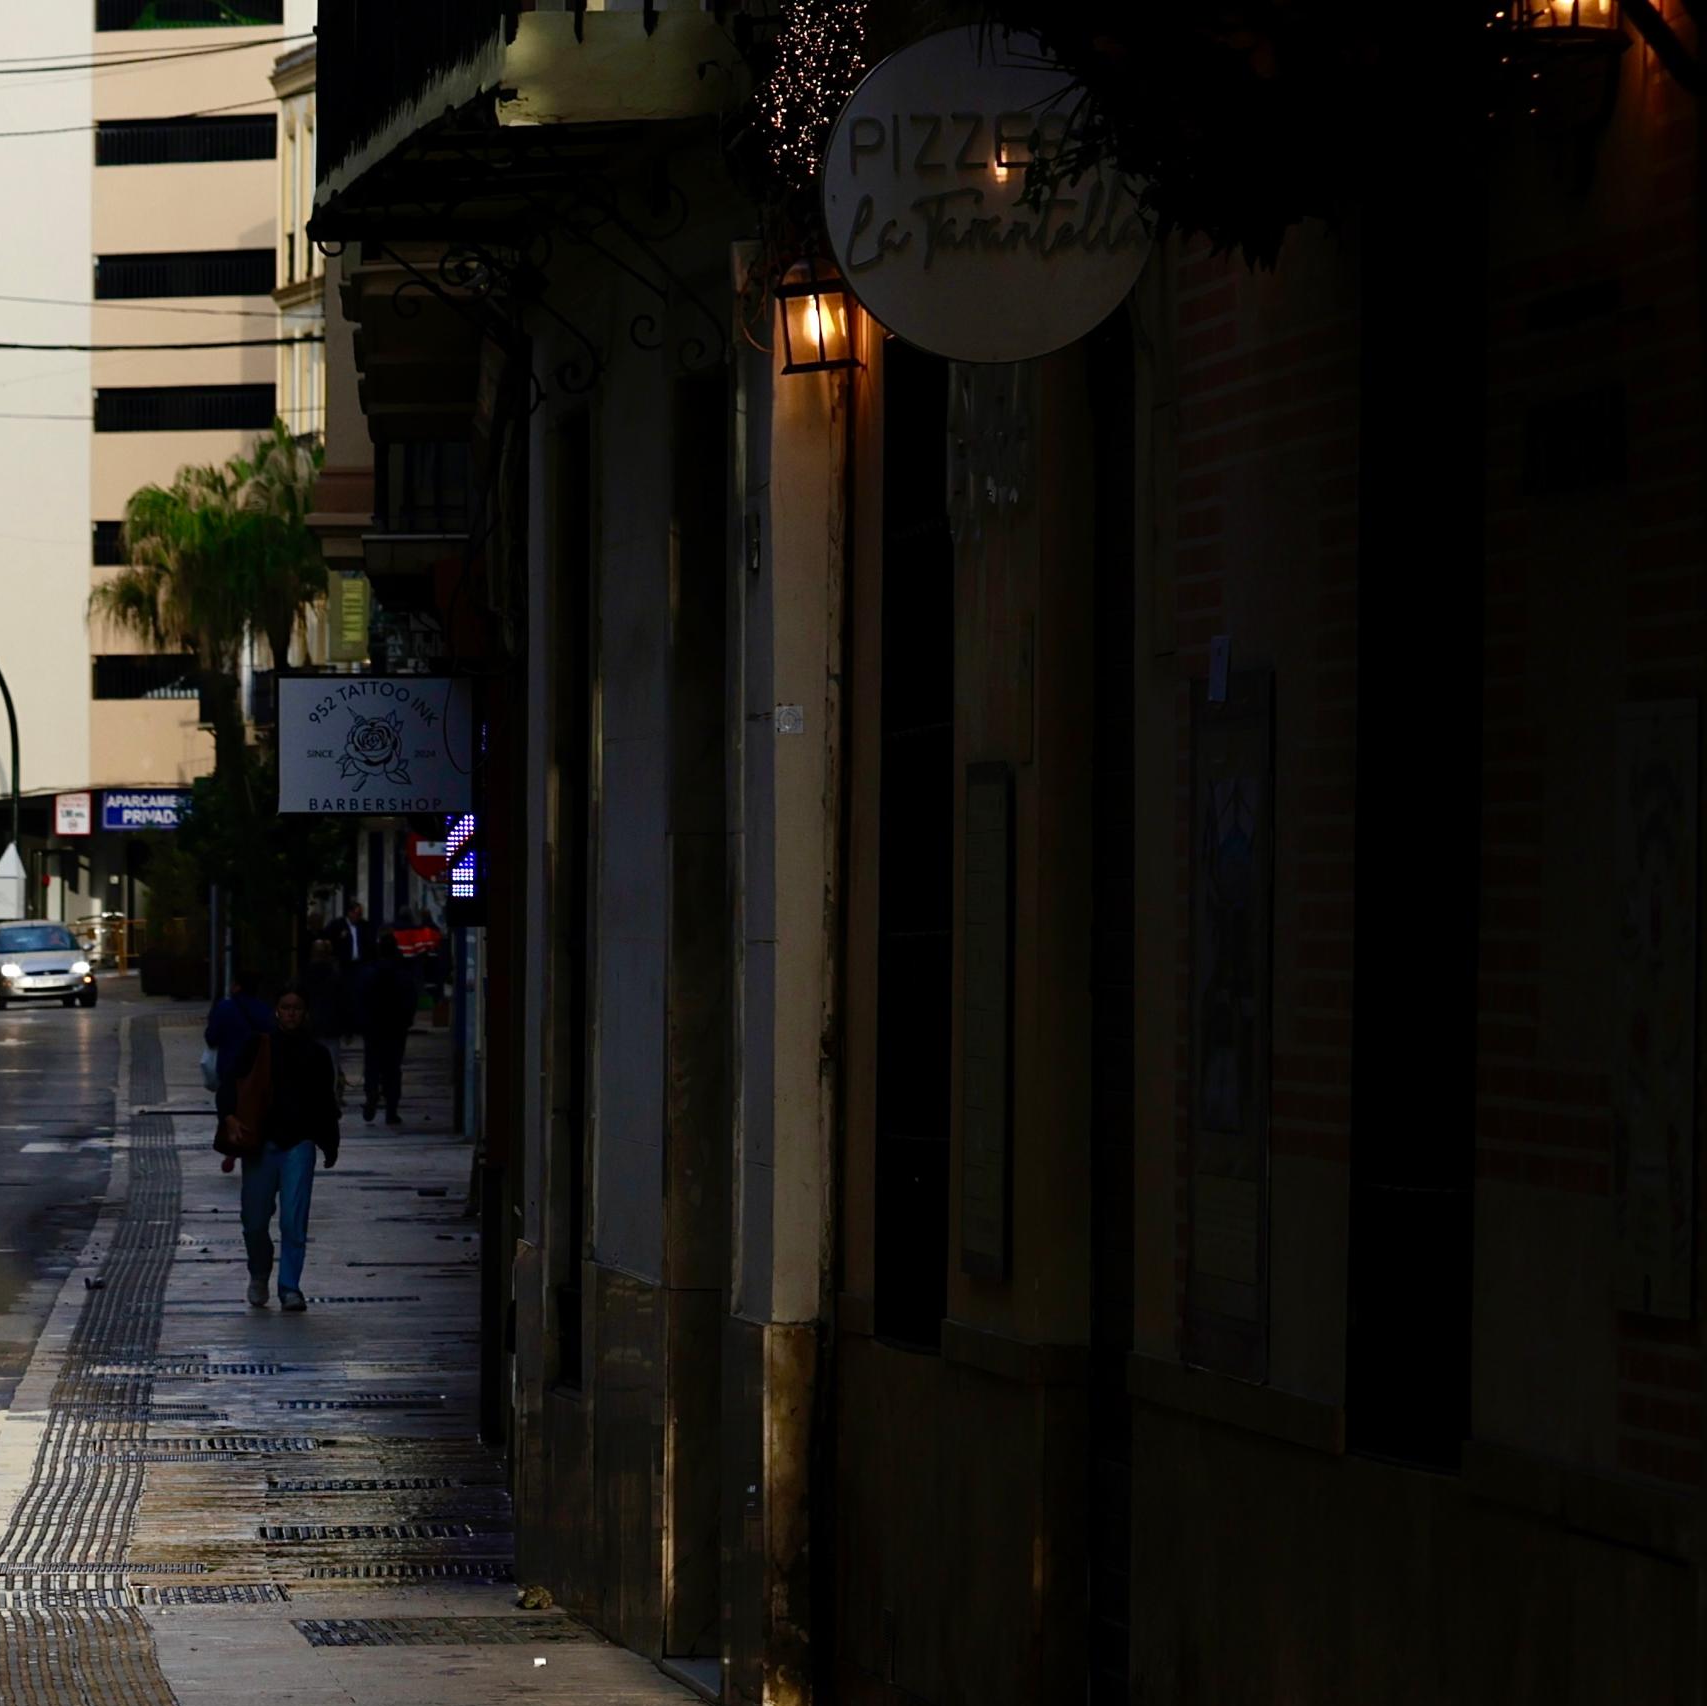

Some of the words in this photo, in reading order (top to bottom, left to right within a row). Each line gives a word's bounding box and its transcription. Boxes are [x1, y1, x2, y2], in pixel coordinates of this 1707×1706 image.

[308, 696, 339, 723] 952
[335, 681, 411, 702] TATTOO
[410, 697, 440, 727] INK
[309, 798, 442, 811] BARBERSHOP
